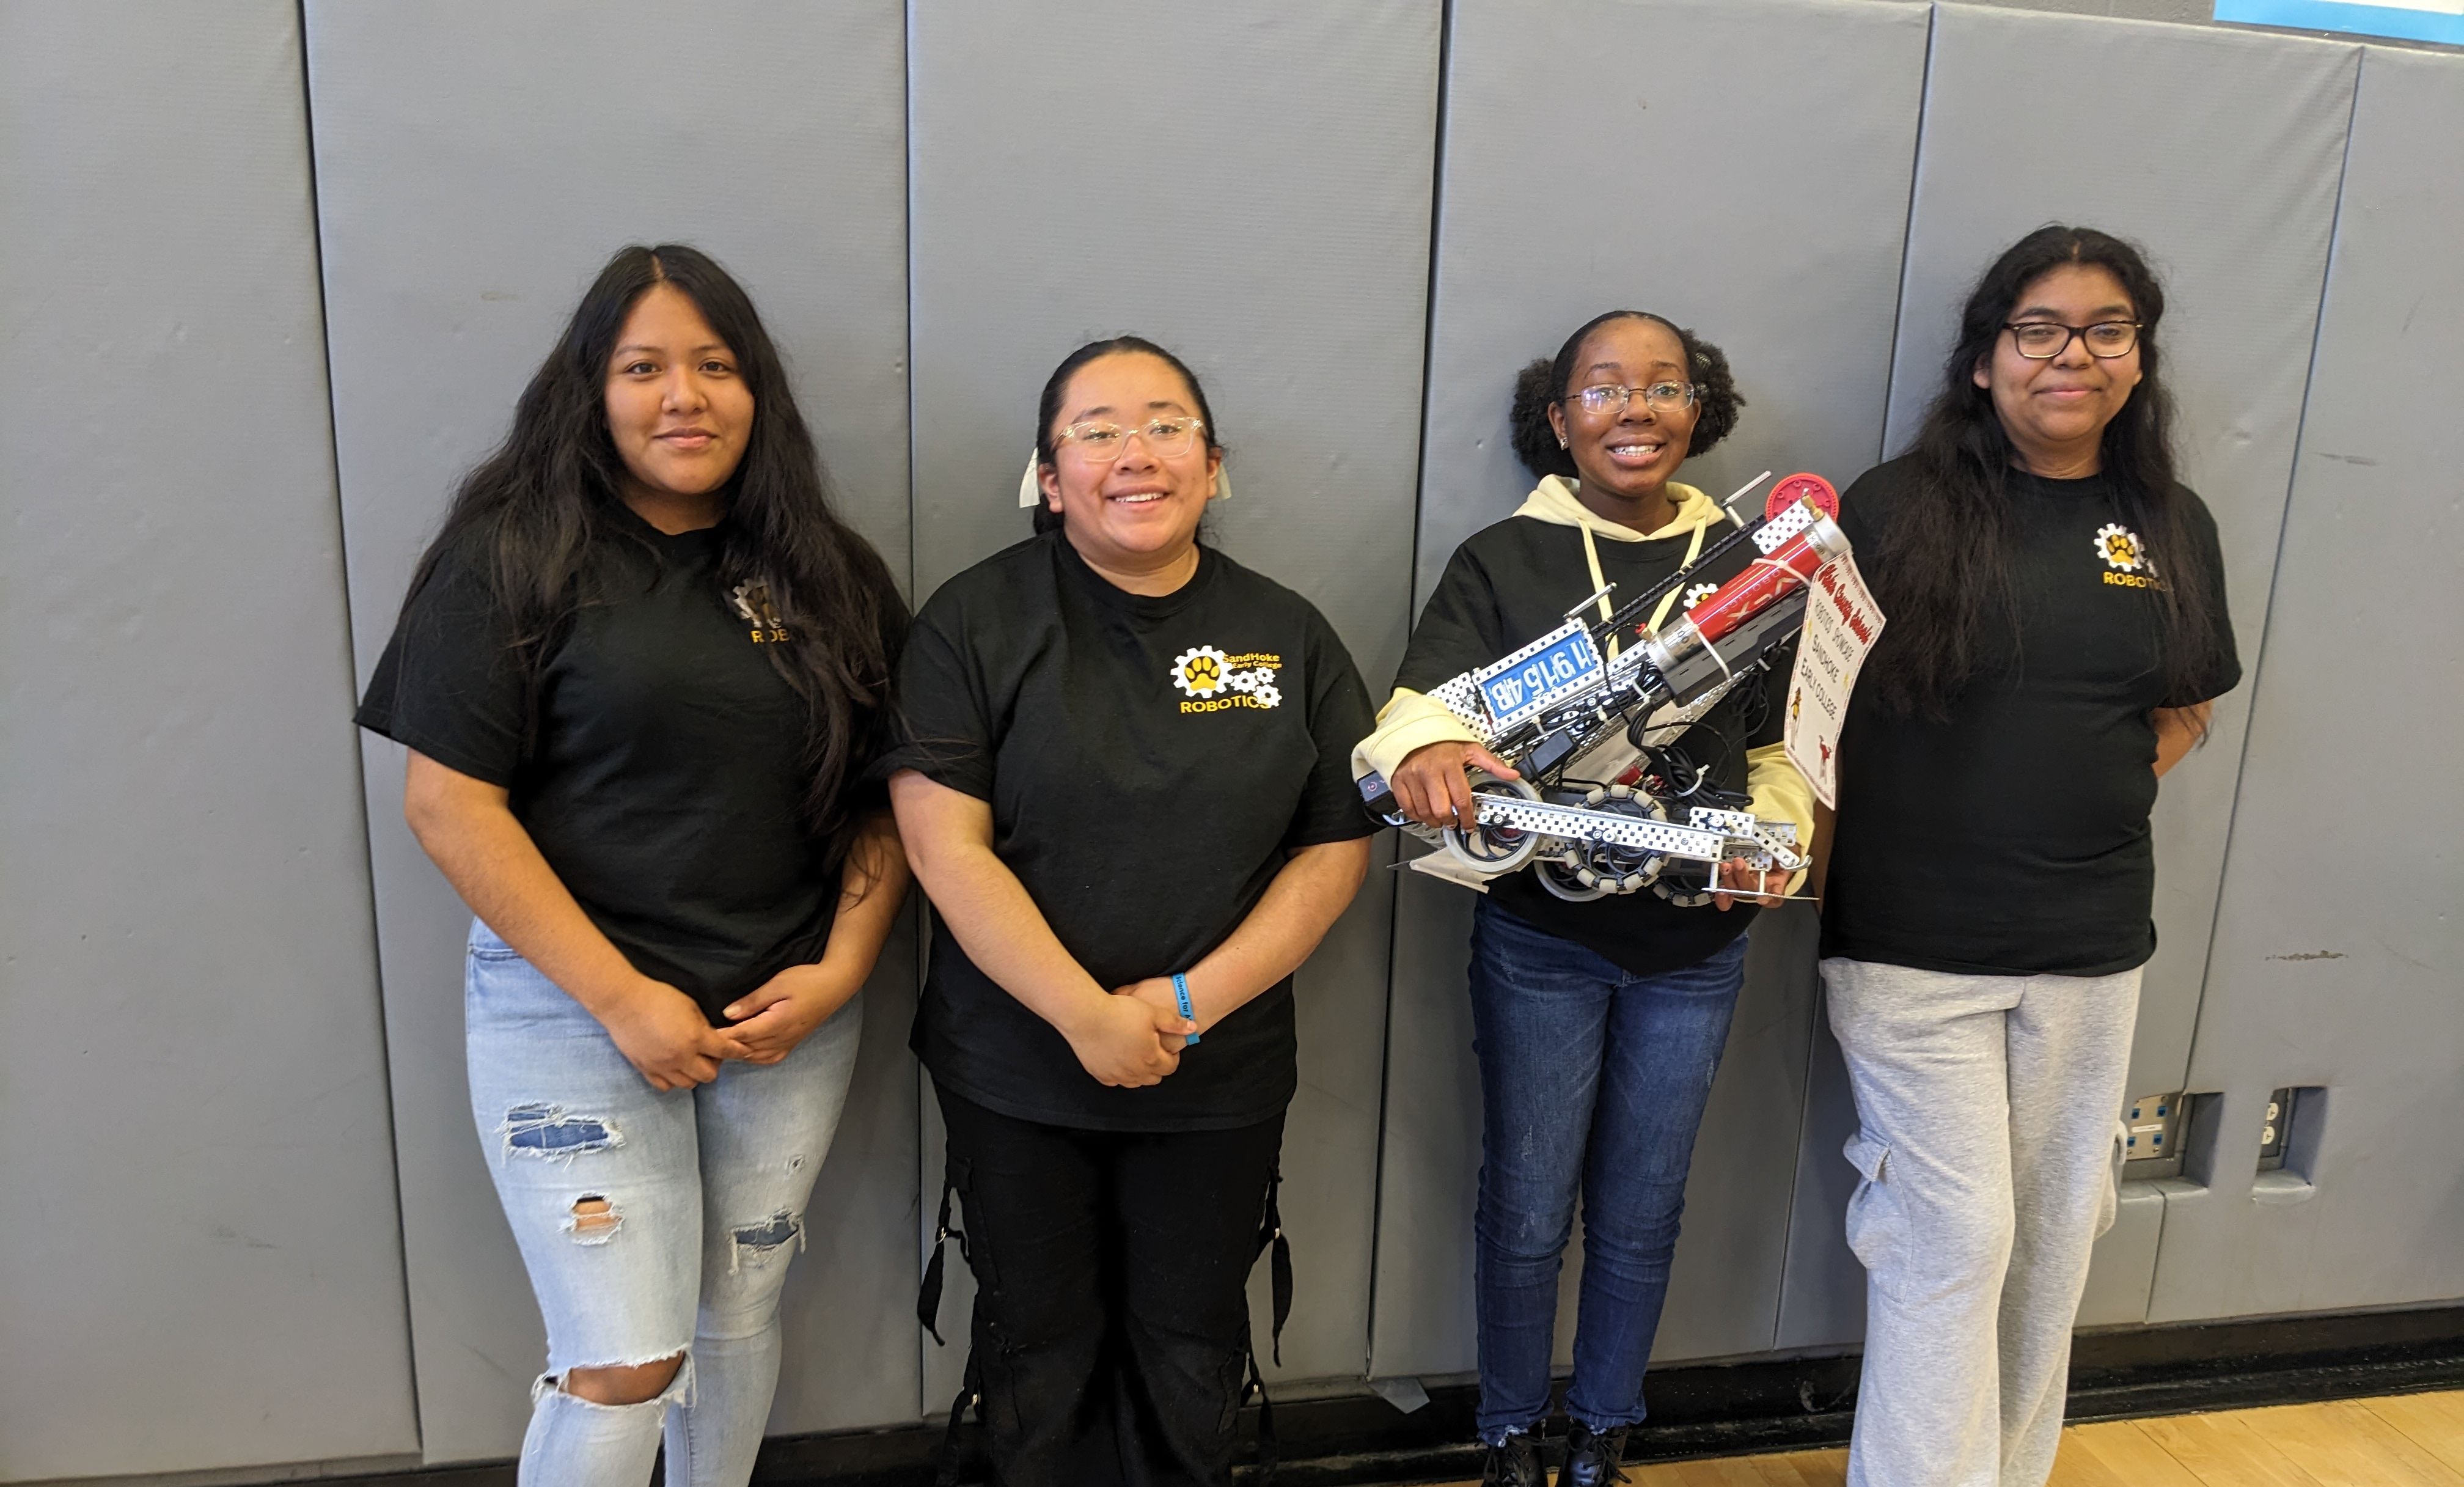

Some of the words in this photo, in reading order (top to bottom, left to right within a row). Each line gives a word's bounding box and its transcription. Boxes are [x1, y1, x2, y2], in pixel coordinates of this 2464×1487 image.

[1818, 564, 1839, 597] Hoke
[1833, 583, 1854, 626] County
[1849, 608, 1874, 645] Schools
[1814, 598, 1834, 634] ROBOTICS
[1832, 627, 1855, 663] SHOWCASE
[1223, 653, 1280, 663] SandHoke
[1253, 661, 1283, 669] College
[1180, 695, 1270, 713] ROBOTICS
[1800, 657, 1817, 692] EARLY
[1815, 683, 1838, 721] COLLEGE
